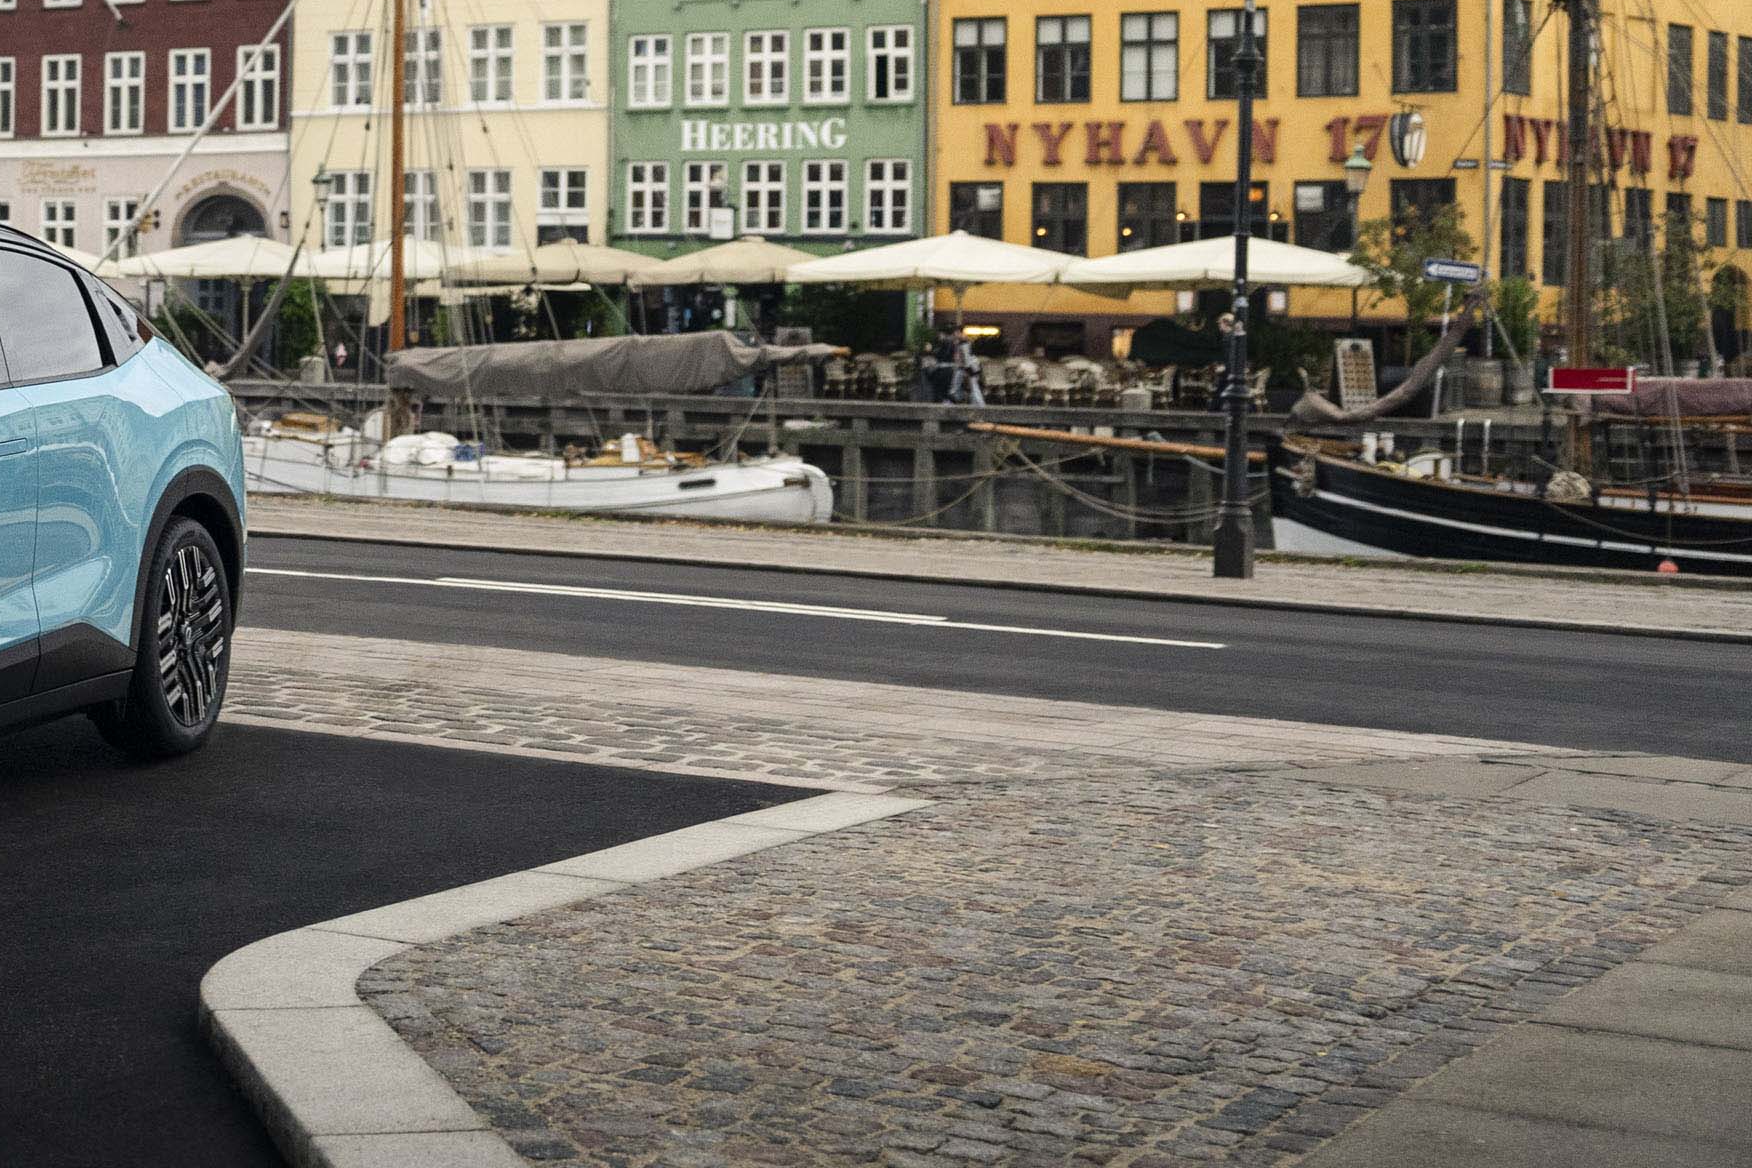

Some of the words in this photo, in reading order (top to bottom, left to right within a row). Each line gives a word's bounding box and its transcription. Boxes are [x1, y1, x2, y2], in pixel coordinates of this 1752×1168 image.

[681, 117, 848, 152] HEERING
[984, 118, 1280, 167] NYHAVN
[1323, 114, 1389, 164] 17
